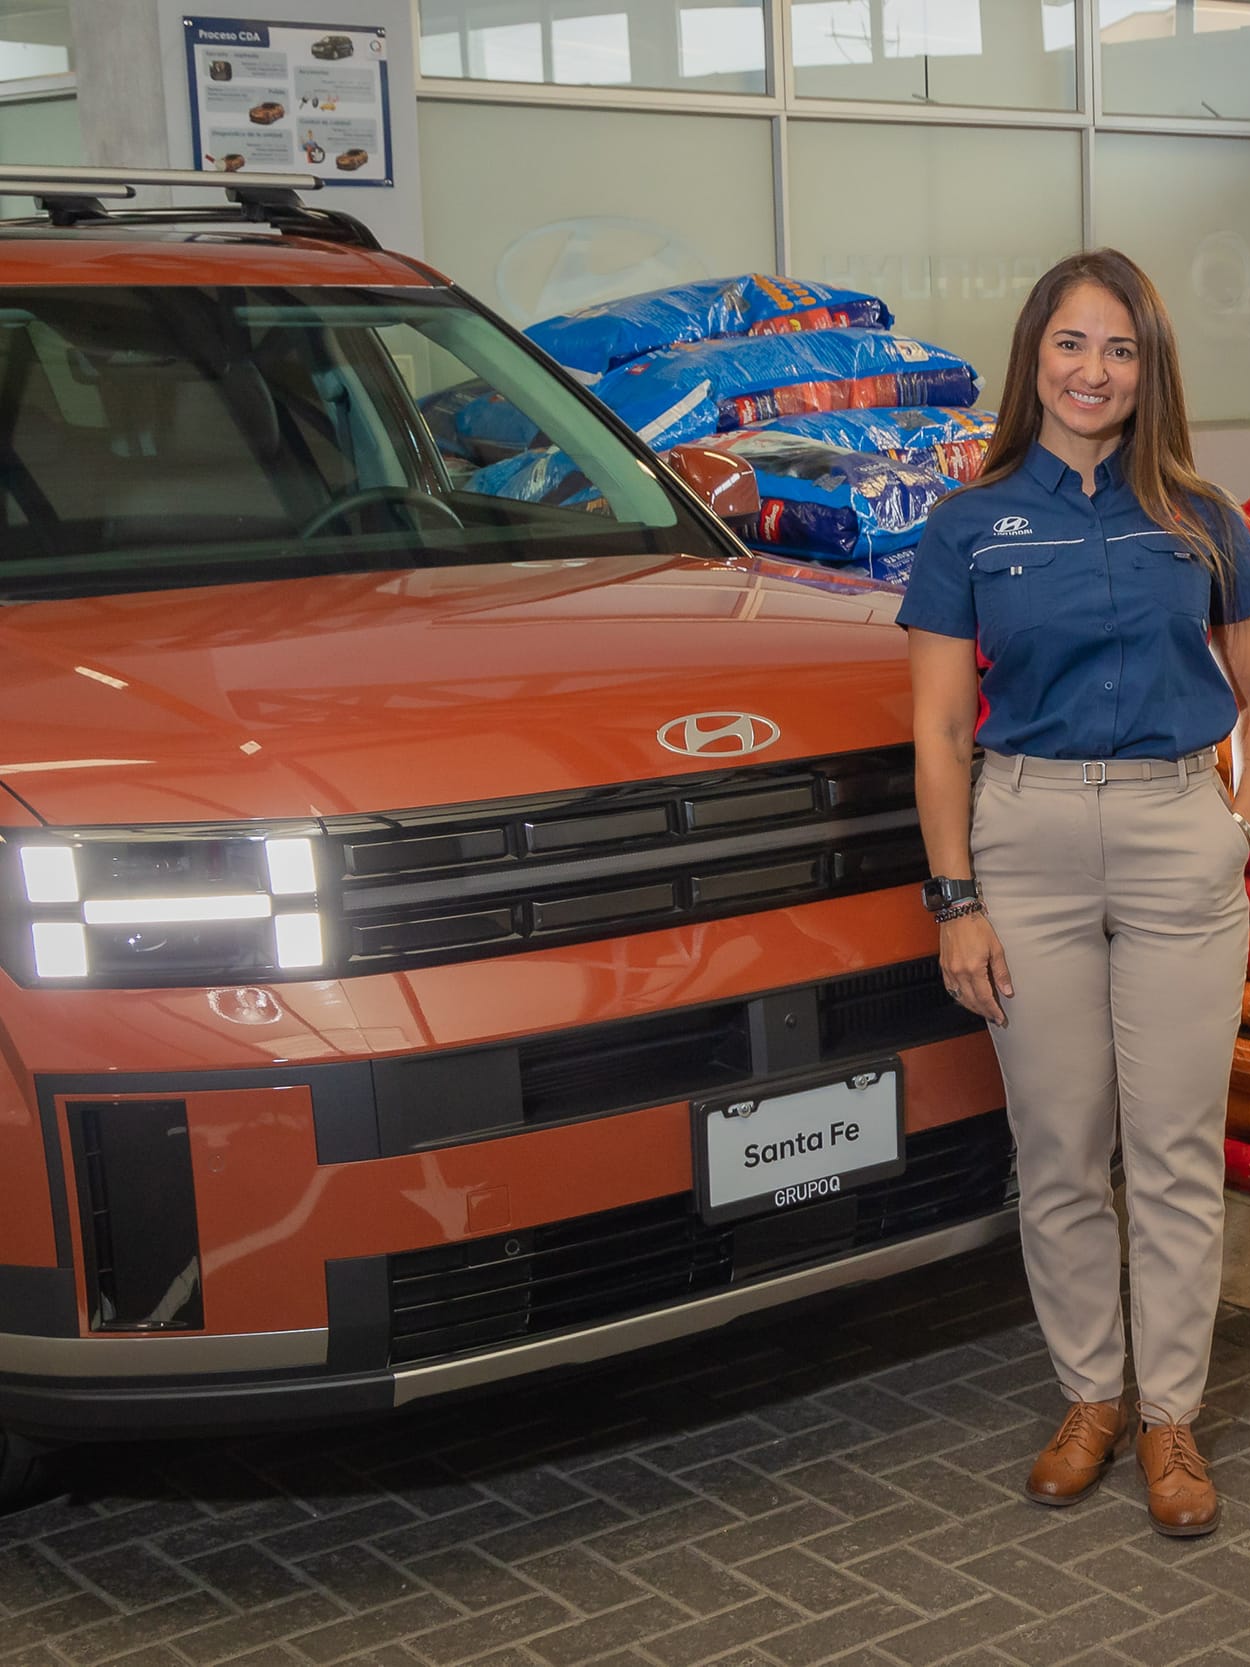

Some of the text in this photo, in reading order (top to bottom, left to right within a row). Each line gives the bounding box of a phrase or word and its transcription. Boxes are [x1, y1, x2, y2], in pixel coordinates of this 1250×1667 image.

[198, 29, 262, 42] Proceso CDA
[743, 1121, 860, 1168] Santa Fe
[774, 1176, 841, 1207] GRUPOQ
